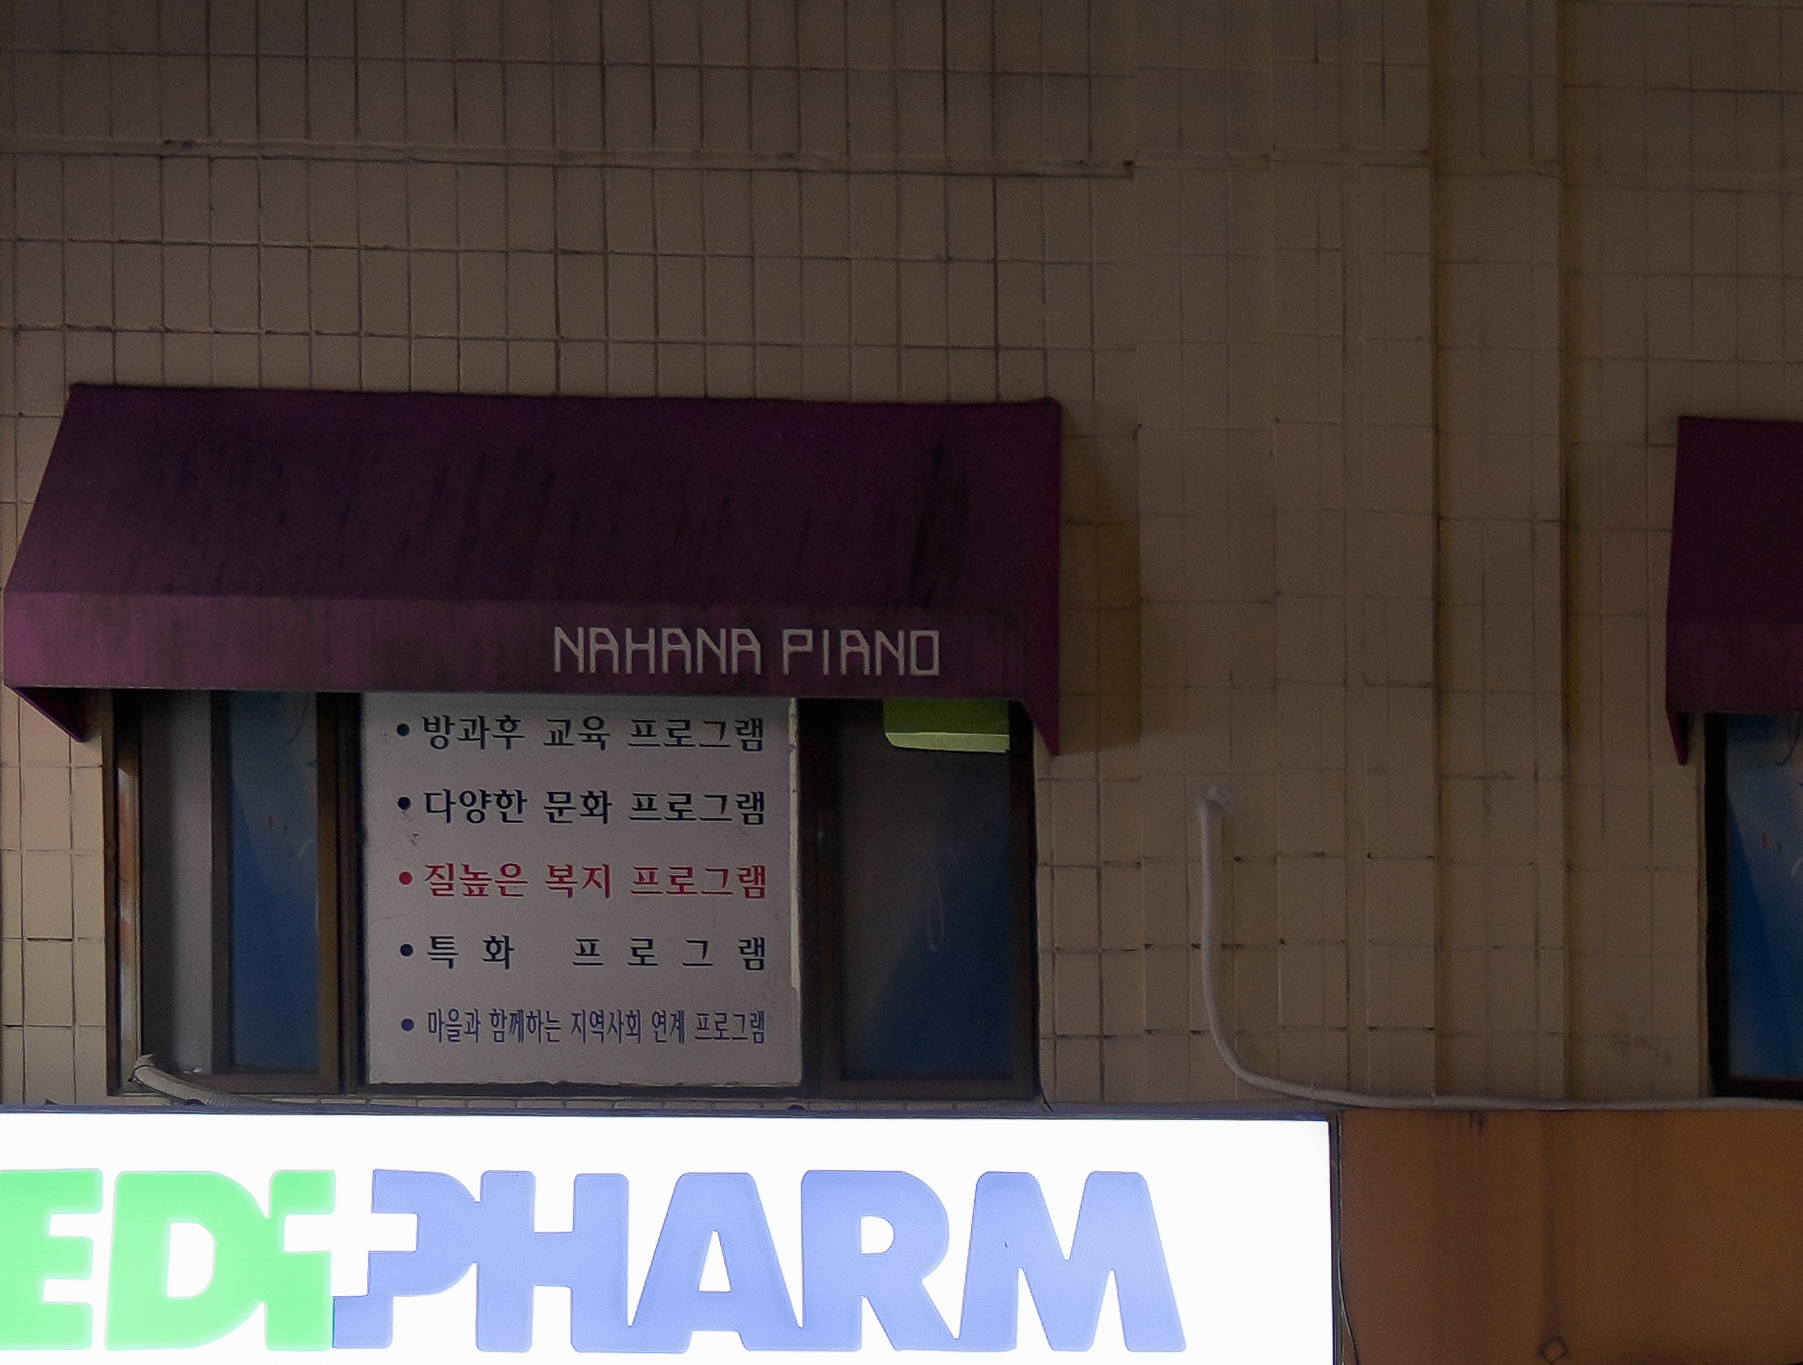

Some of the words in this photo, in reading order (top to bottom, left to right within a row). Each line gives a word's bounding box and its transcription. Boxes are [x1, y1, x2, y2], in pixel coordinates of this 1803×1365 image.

[552, 626, 763, 676] NAHANA
[781, 628, 941, 677] PIANO
[421, 714, 525, 751] 방과후
[542, 714, 607, 751] 교육
[627, 716, 765, 752] 프로그램
[424, 788, 527, 826] 다양한
[544, 788, 612, 826] 문화
[627, 790, 765, 826] 프로그램
[424, 862, 528, 900] 질높은
[544, 863, 612, 900] 복지
[629, 863, 767, 900] 프로그램
[426, 1009, 481, 1044] 마을과
[487, 1008, 561, 1046] 함께하는
[570, 1008, 643, 1046] 지역사회
[650, 1008, 686, 1045] 연계
[693, 1009, 766, 1046] 프로그램
